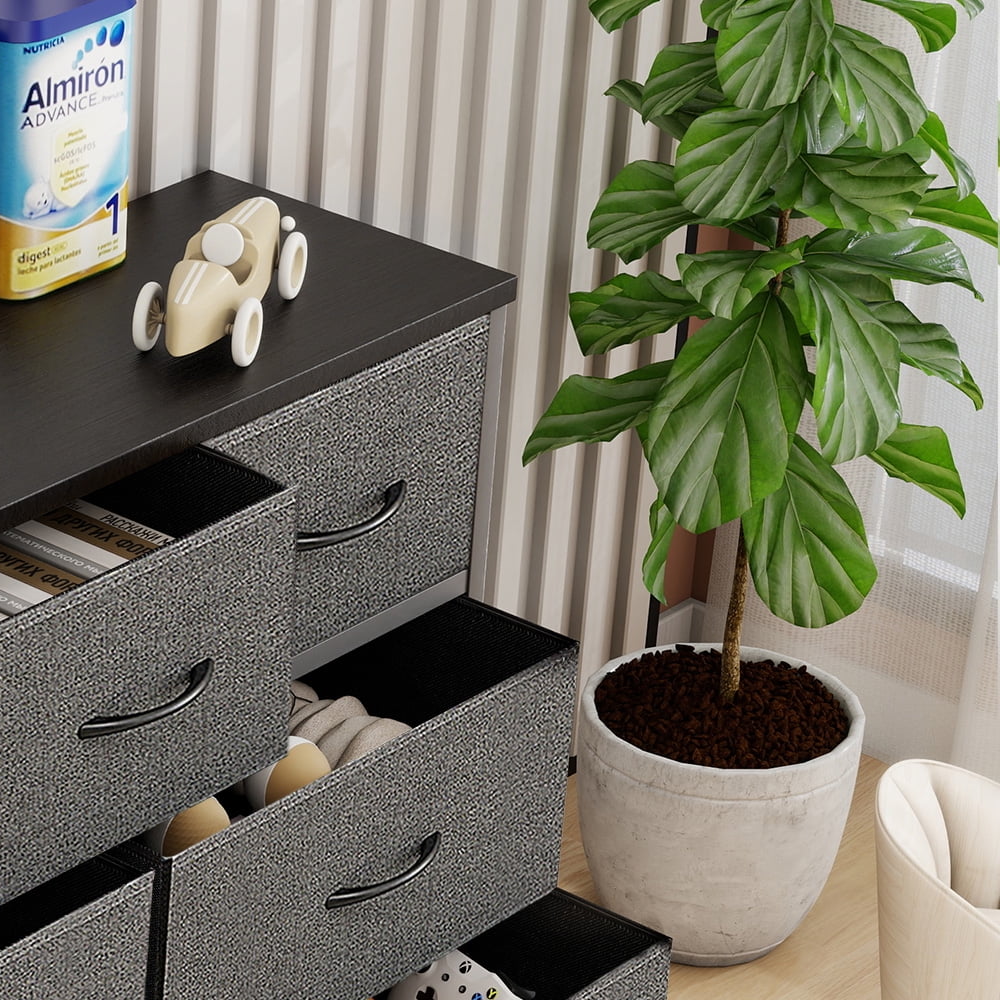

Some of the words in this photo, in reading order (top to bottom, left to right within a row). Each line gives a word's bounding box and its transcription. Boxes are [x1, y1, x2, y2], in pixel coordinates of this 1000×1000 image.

[23, 36, 65, 55] NUTRICIA
[21, 58, 125, 114] Almirón
[20, 94, 98, 130] ADVANCE
[106, 192, 119, 235] 1
[17, 247, 51, 265] digest
[54, 513, 120, 542] ДРУГИХ
[100, 513, 161, 545] РАССКАЖИ
